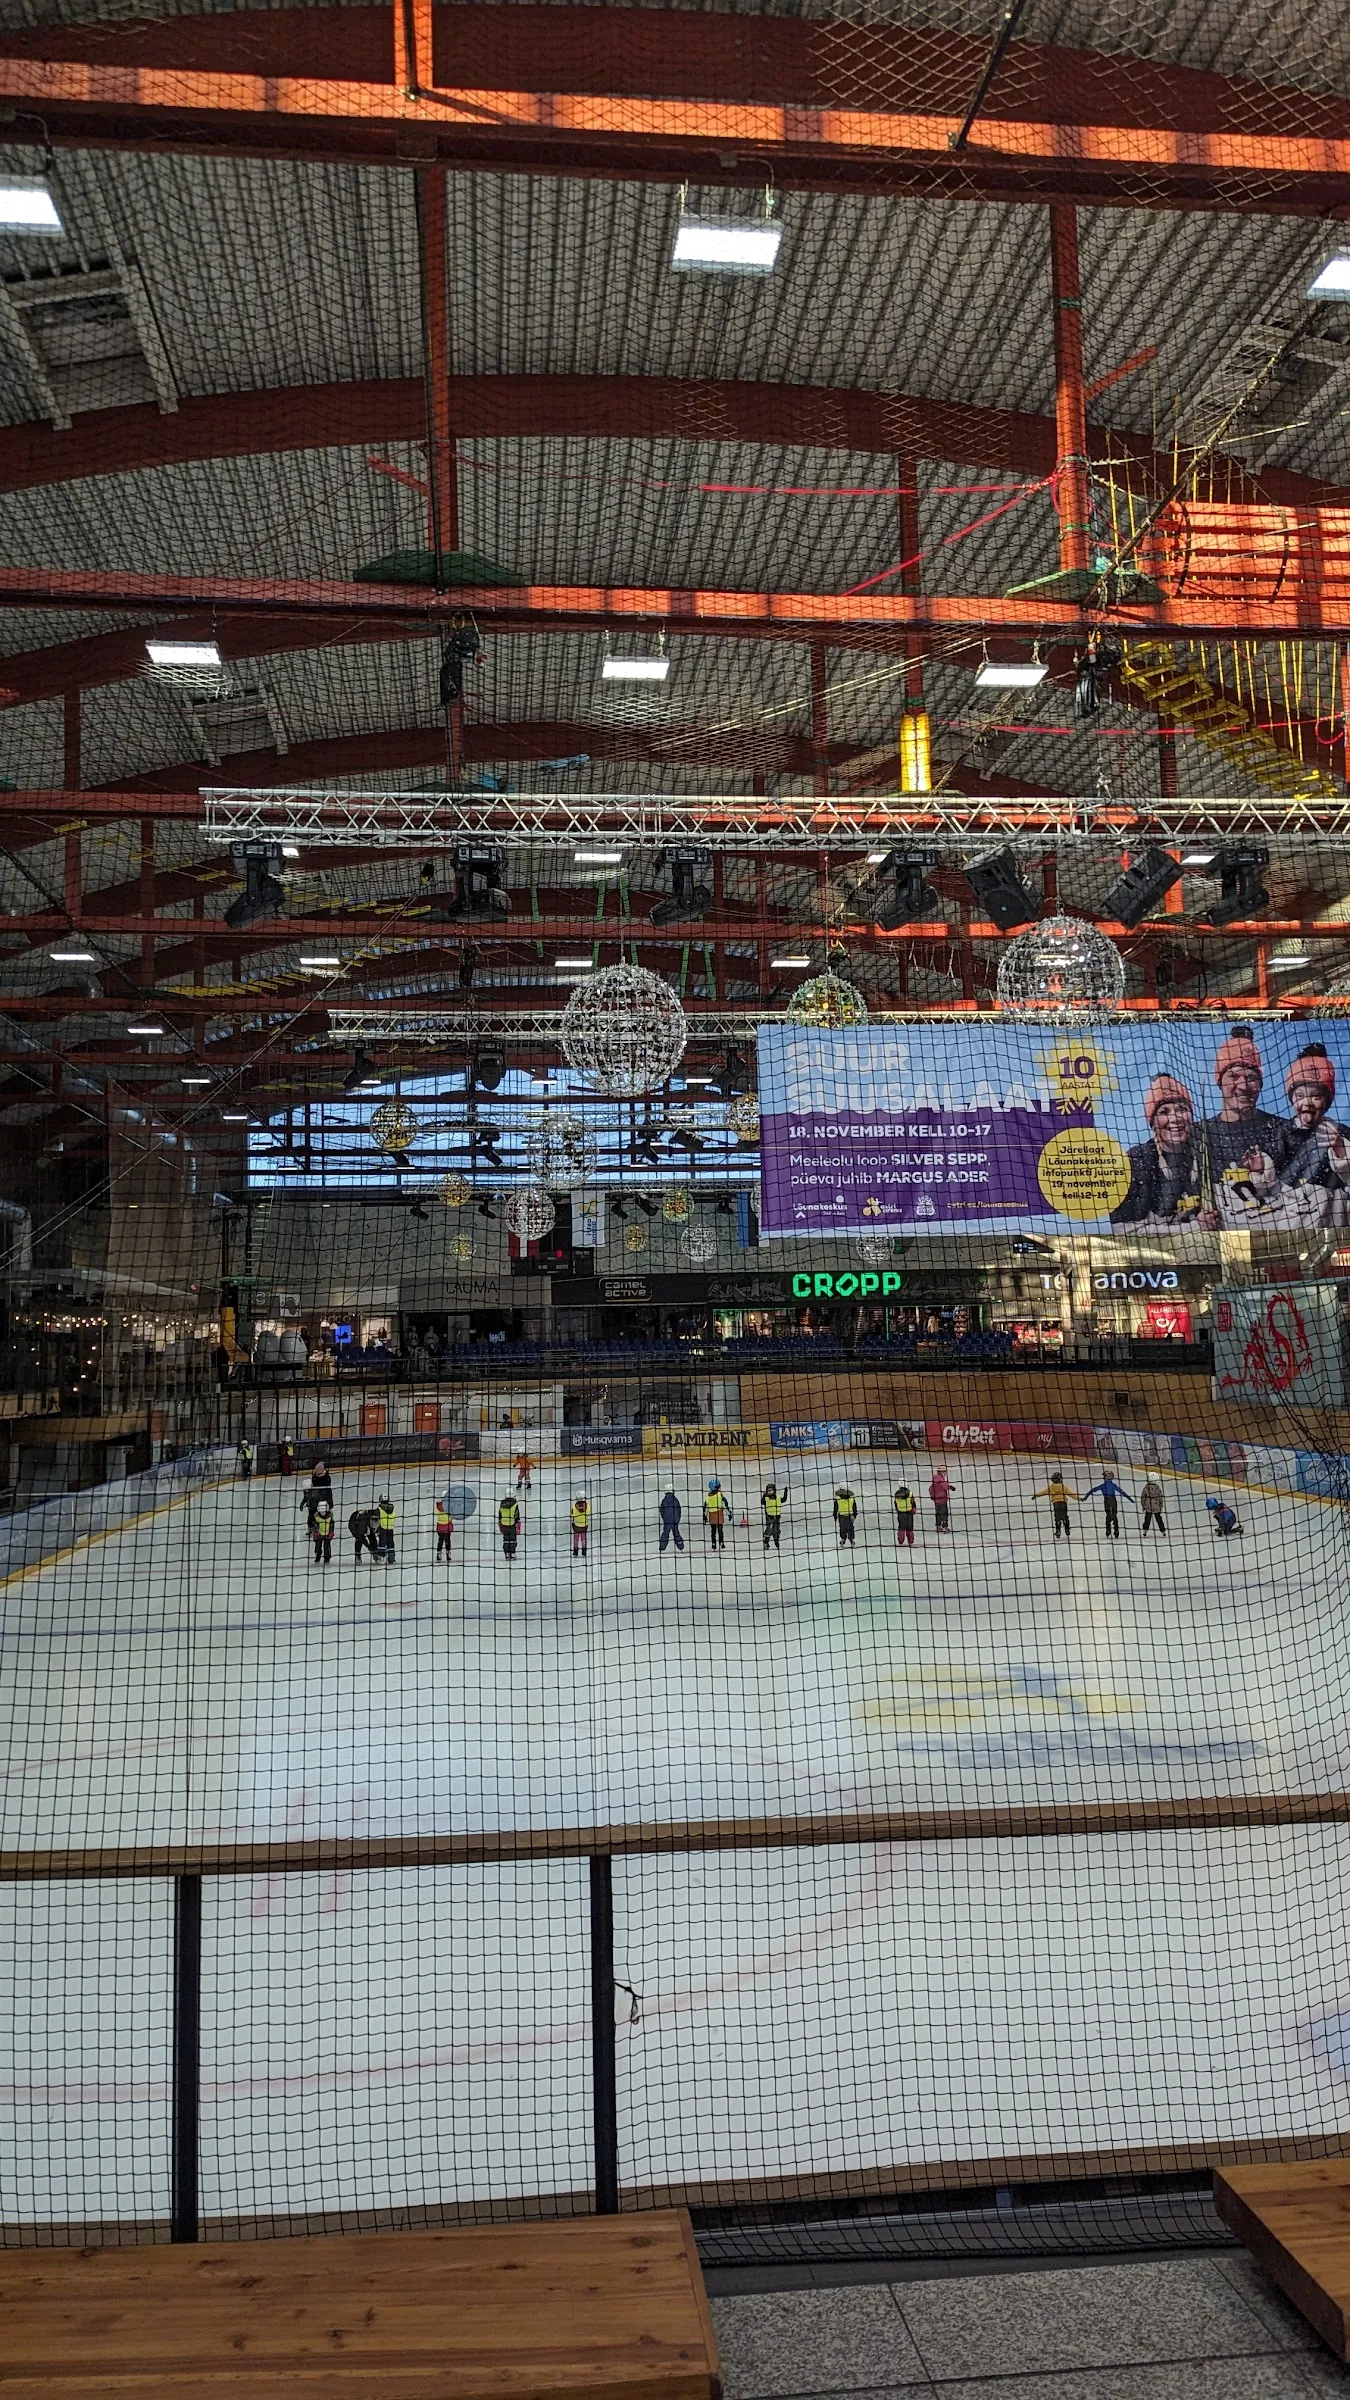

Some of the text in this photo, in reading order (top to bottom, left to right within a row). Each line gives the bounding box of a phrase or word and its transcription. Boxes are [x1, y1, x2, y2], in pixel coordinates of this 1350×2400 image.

[787, 1042, 909, 1074] SUUR
[1060, 1056, 1094, 1079] 10
[787, 1079, 1058, 1115] SUUSALAAT
[789, 1126, 810, 1138] 18.
[814, 1125, 905, 1138] NOVEMBER
[908, 1125, 947, 1137] KELL
[1059, 1146, 1105, 1154] Järellaat
[790, 1155, 853, 1167] Meeleolu
[857, 1155, 888, 1166] loob
[891, 1153, 943, 1165] SILVER
[791, 1171, 989, 1187] päeva juhib MARGUS ADER
[1094, 1169, 1125, 1178] juures
[1067, 1180, 1117, 1188] november
[604, 1280, 646, 1289] camel
[792, 1272, 901, 1298] CROPP
[1040, 1270, 1179, 1290] Teanova
[446, 1281, 498, 1294] LAUMA
[604, 1288, 647, 1297] active
[583, 1435, 633, 1445] Husqvarna
[661, 1431, 750, 1447] RAMIRENT
[942, 1425, 995, 1447] OlyBet
